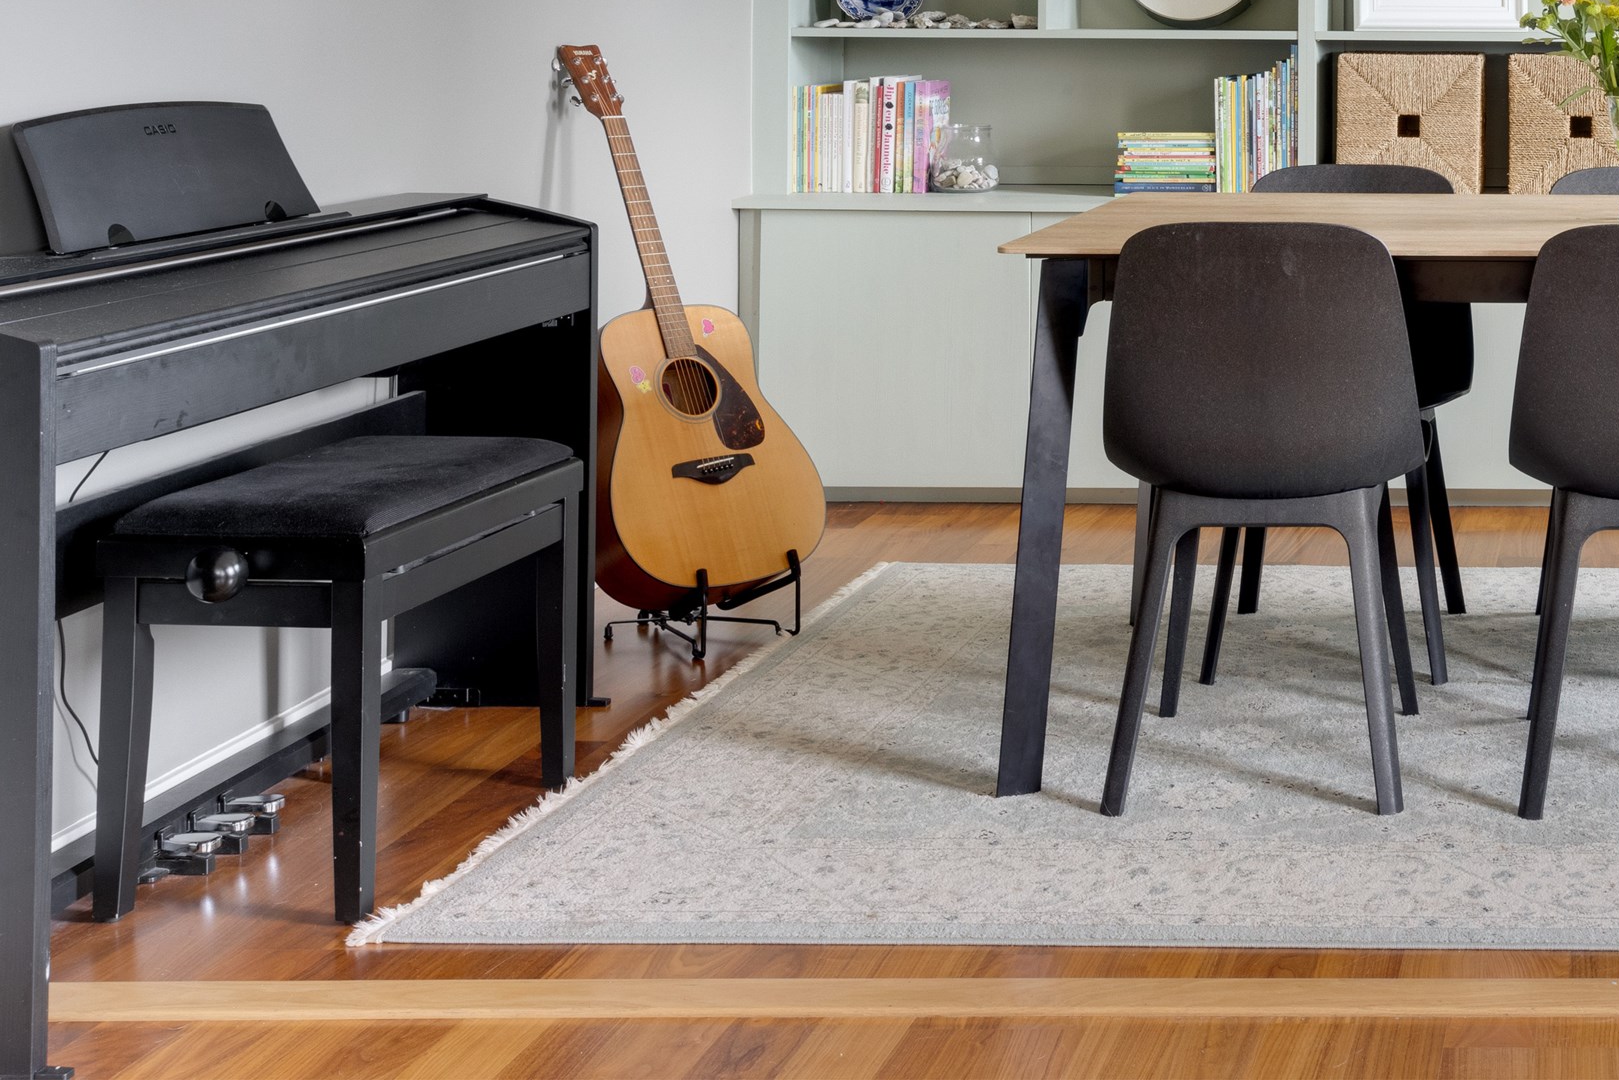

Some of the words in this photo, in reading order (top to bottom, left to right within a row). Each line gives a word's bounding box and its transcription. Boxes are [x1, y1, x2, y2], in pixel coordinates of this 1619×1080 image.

[885, 84, 894, 100] Jip
[885, 110, 892, 122] en
[144, 124, 176, 135] CASIO
[883, 132, 892, 174] Janneke
